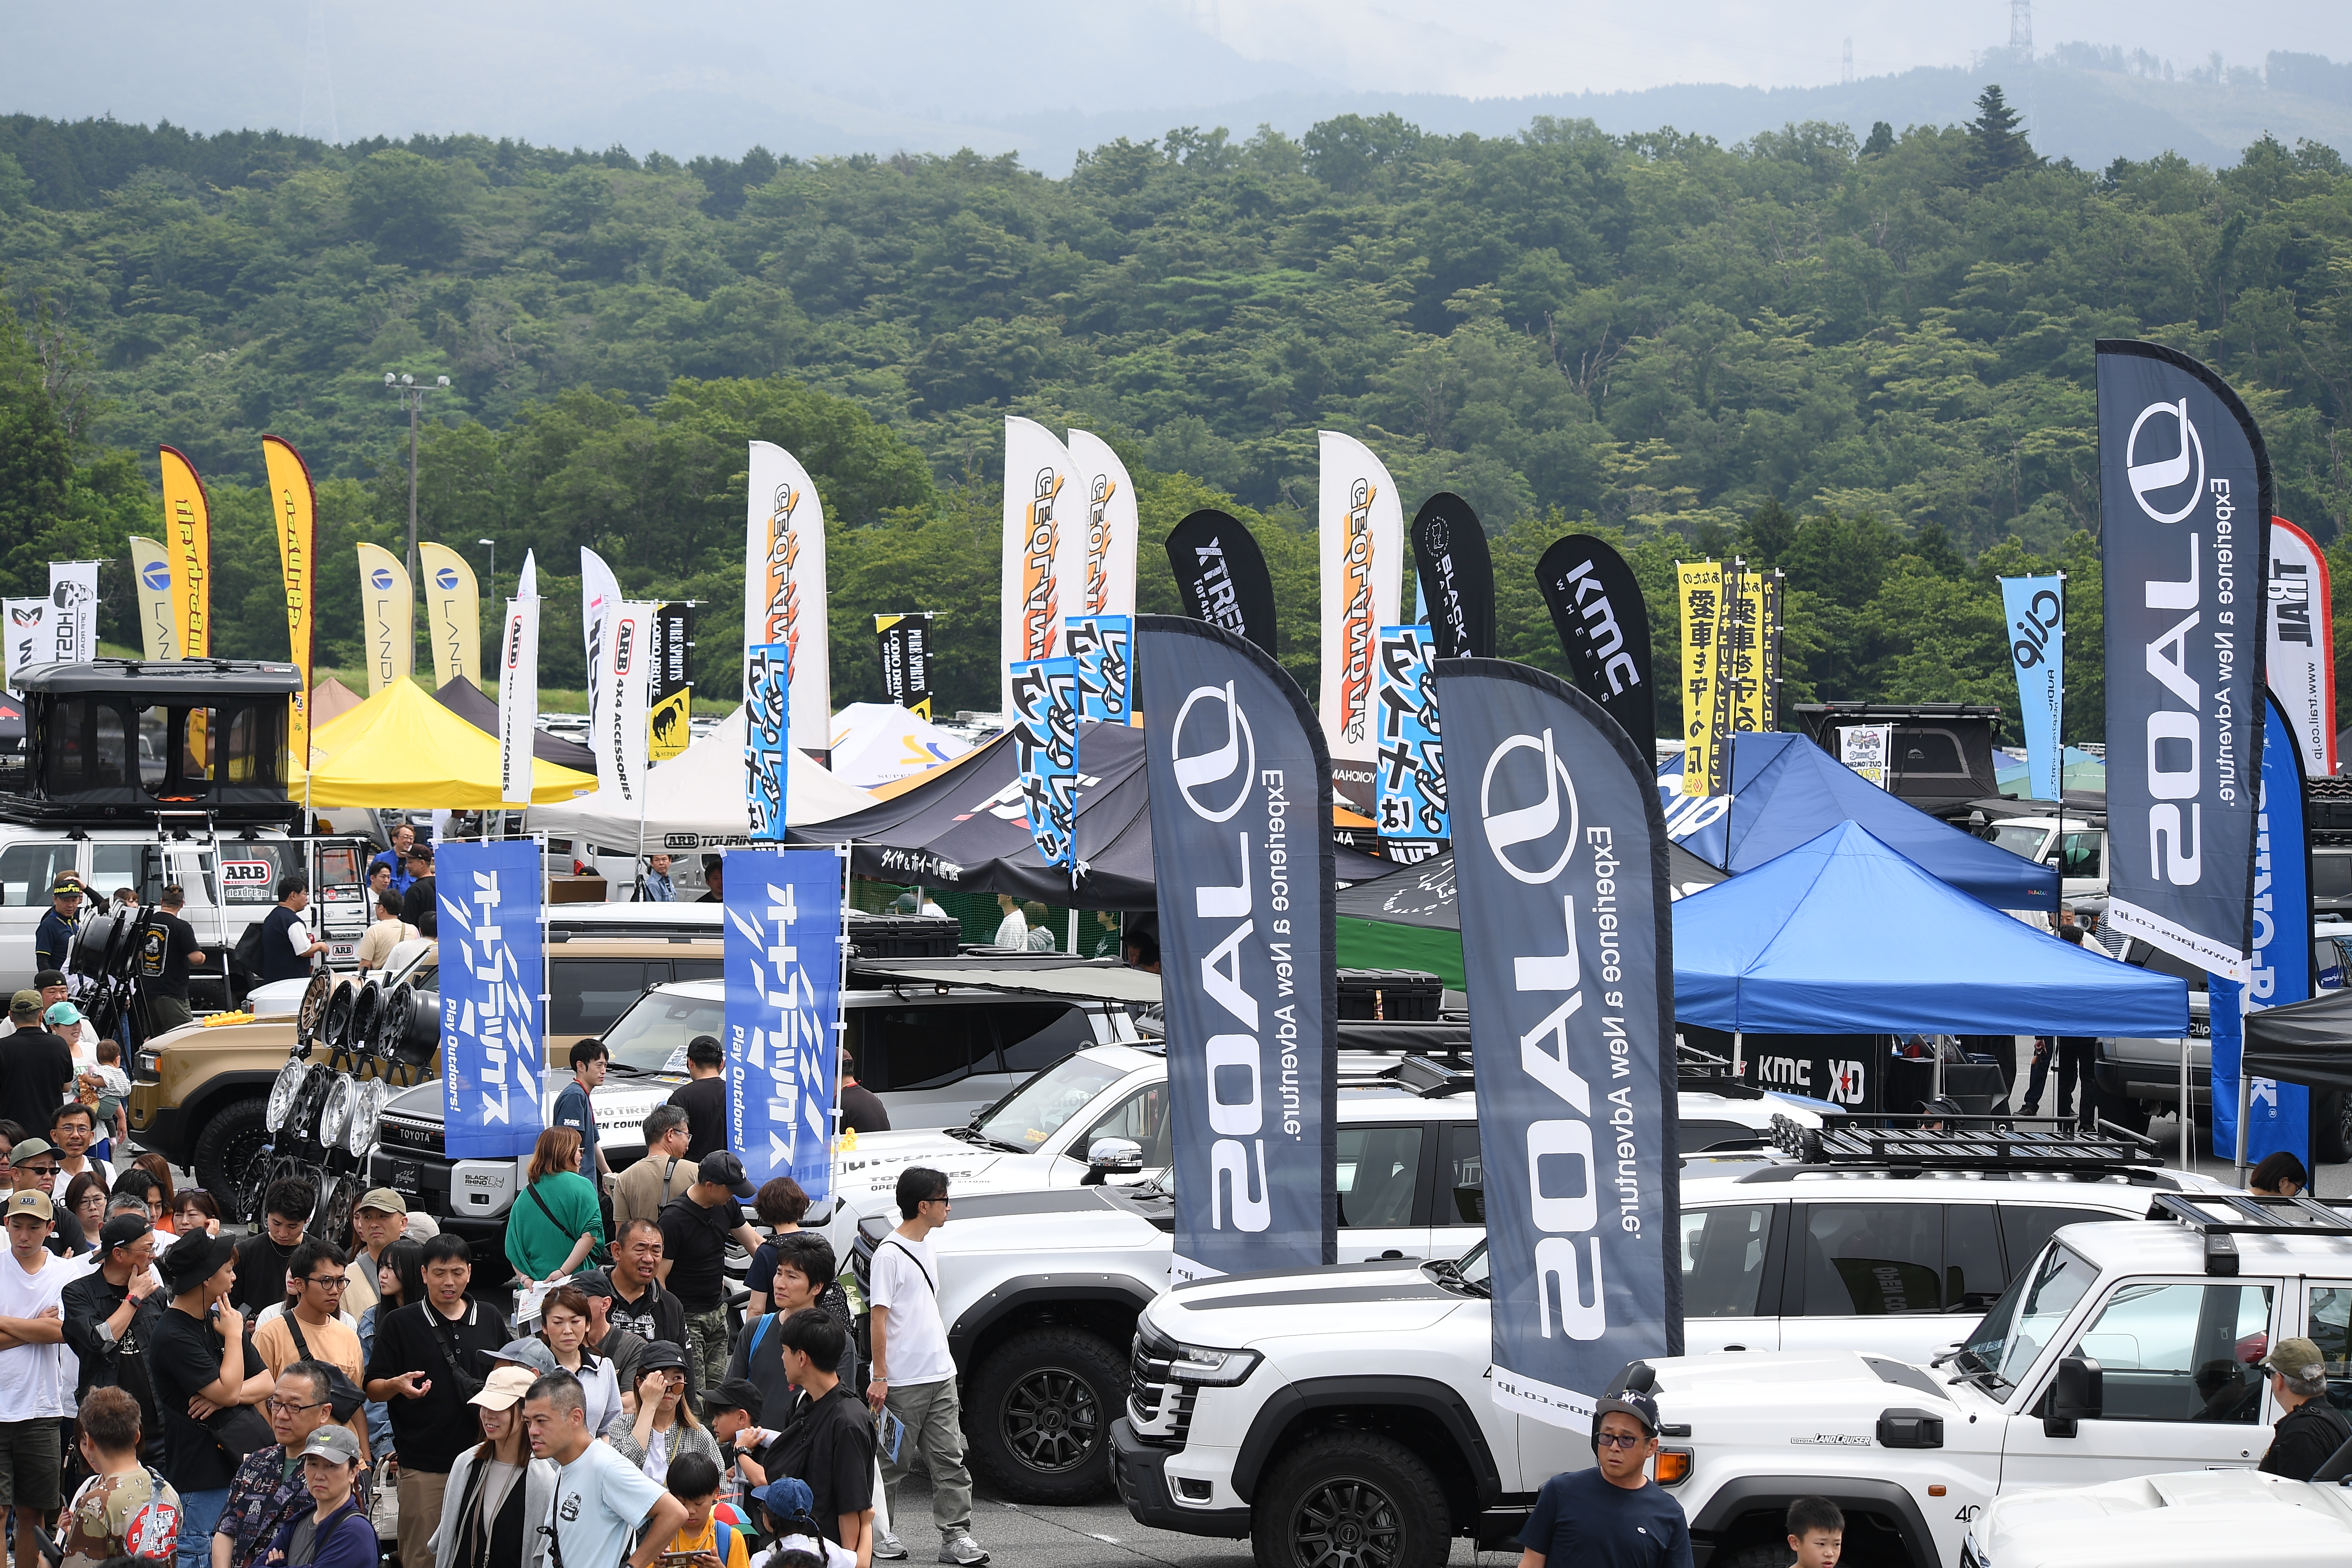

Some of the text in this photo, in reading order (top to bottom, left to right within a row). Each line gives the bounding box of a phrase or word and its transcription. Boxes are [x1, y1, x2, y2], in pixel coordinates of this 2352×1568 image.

[1435, 562, 1453, 625] HARD
[1441, 553, 1467, 645] BLACK
[617, 625, 632, 670] ARB
[669, 618, 684, 681] PURE SPIRITS
[890, 629, 901, 667] LODIO
[908, 629, 925, 691] PURE SPIRITS
[1556, 578, 1609, 702] WHEELS
[613, 678, 632, 801] 4X4 ACCESSORIES
[668, 836, 696, 846] ARB
[701, 835, 751, 847] TOURIN
[225, 866, 265, 879] ARB
[226, 887, 270, 897] flexdream
[444, 998, 461, 1113] Play Outdoors!
[617, 1105, 651, 1115] TIRE
[732, 1024, 746, 1153] Play Outdoors!
[400, 1129, 430, 1142] TOYOTA
[613, 1120, 644, 1128] COUN
[140, 1511, 174, 1523] SUEME
